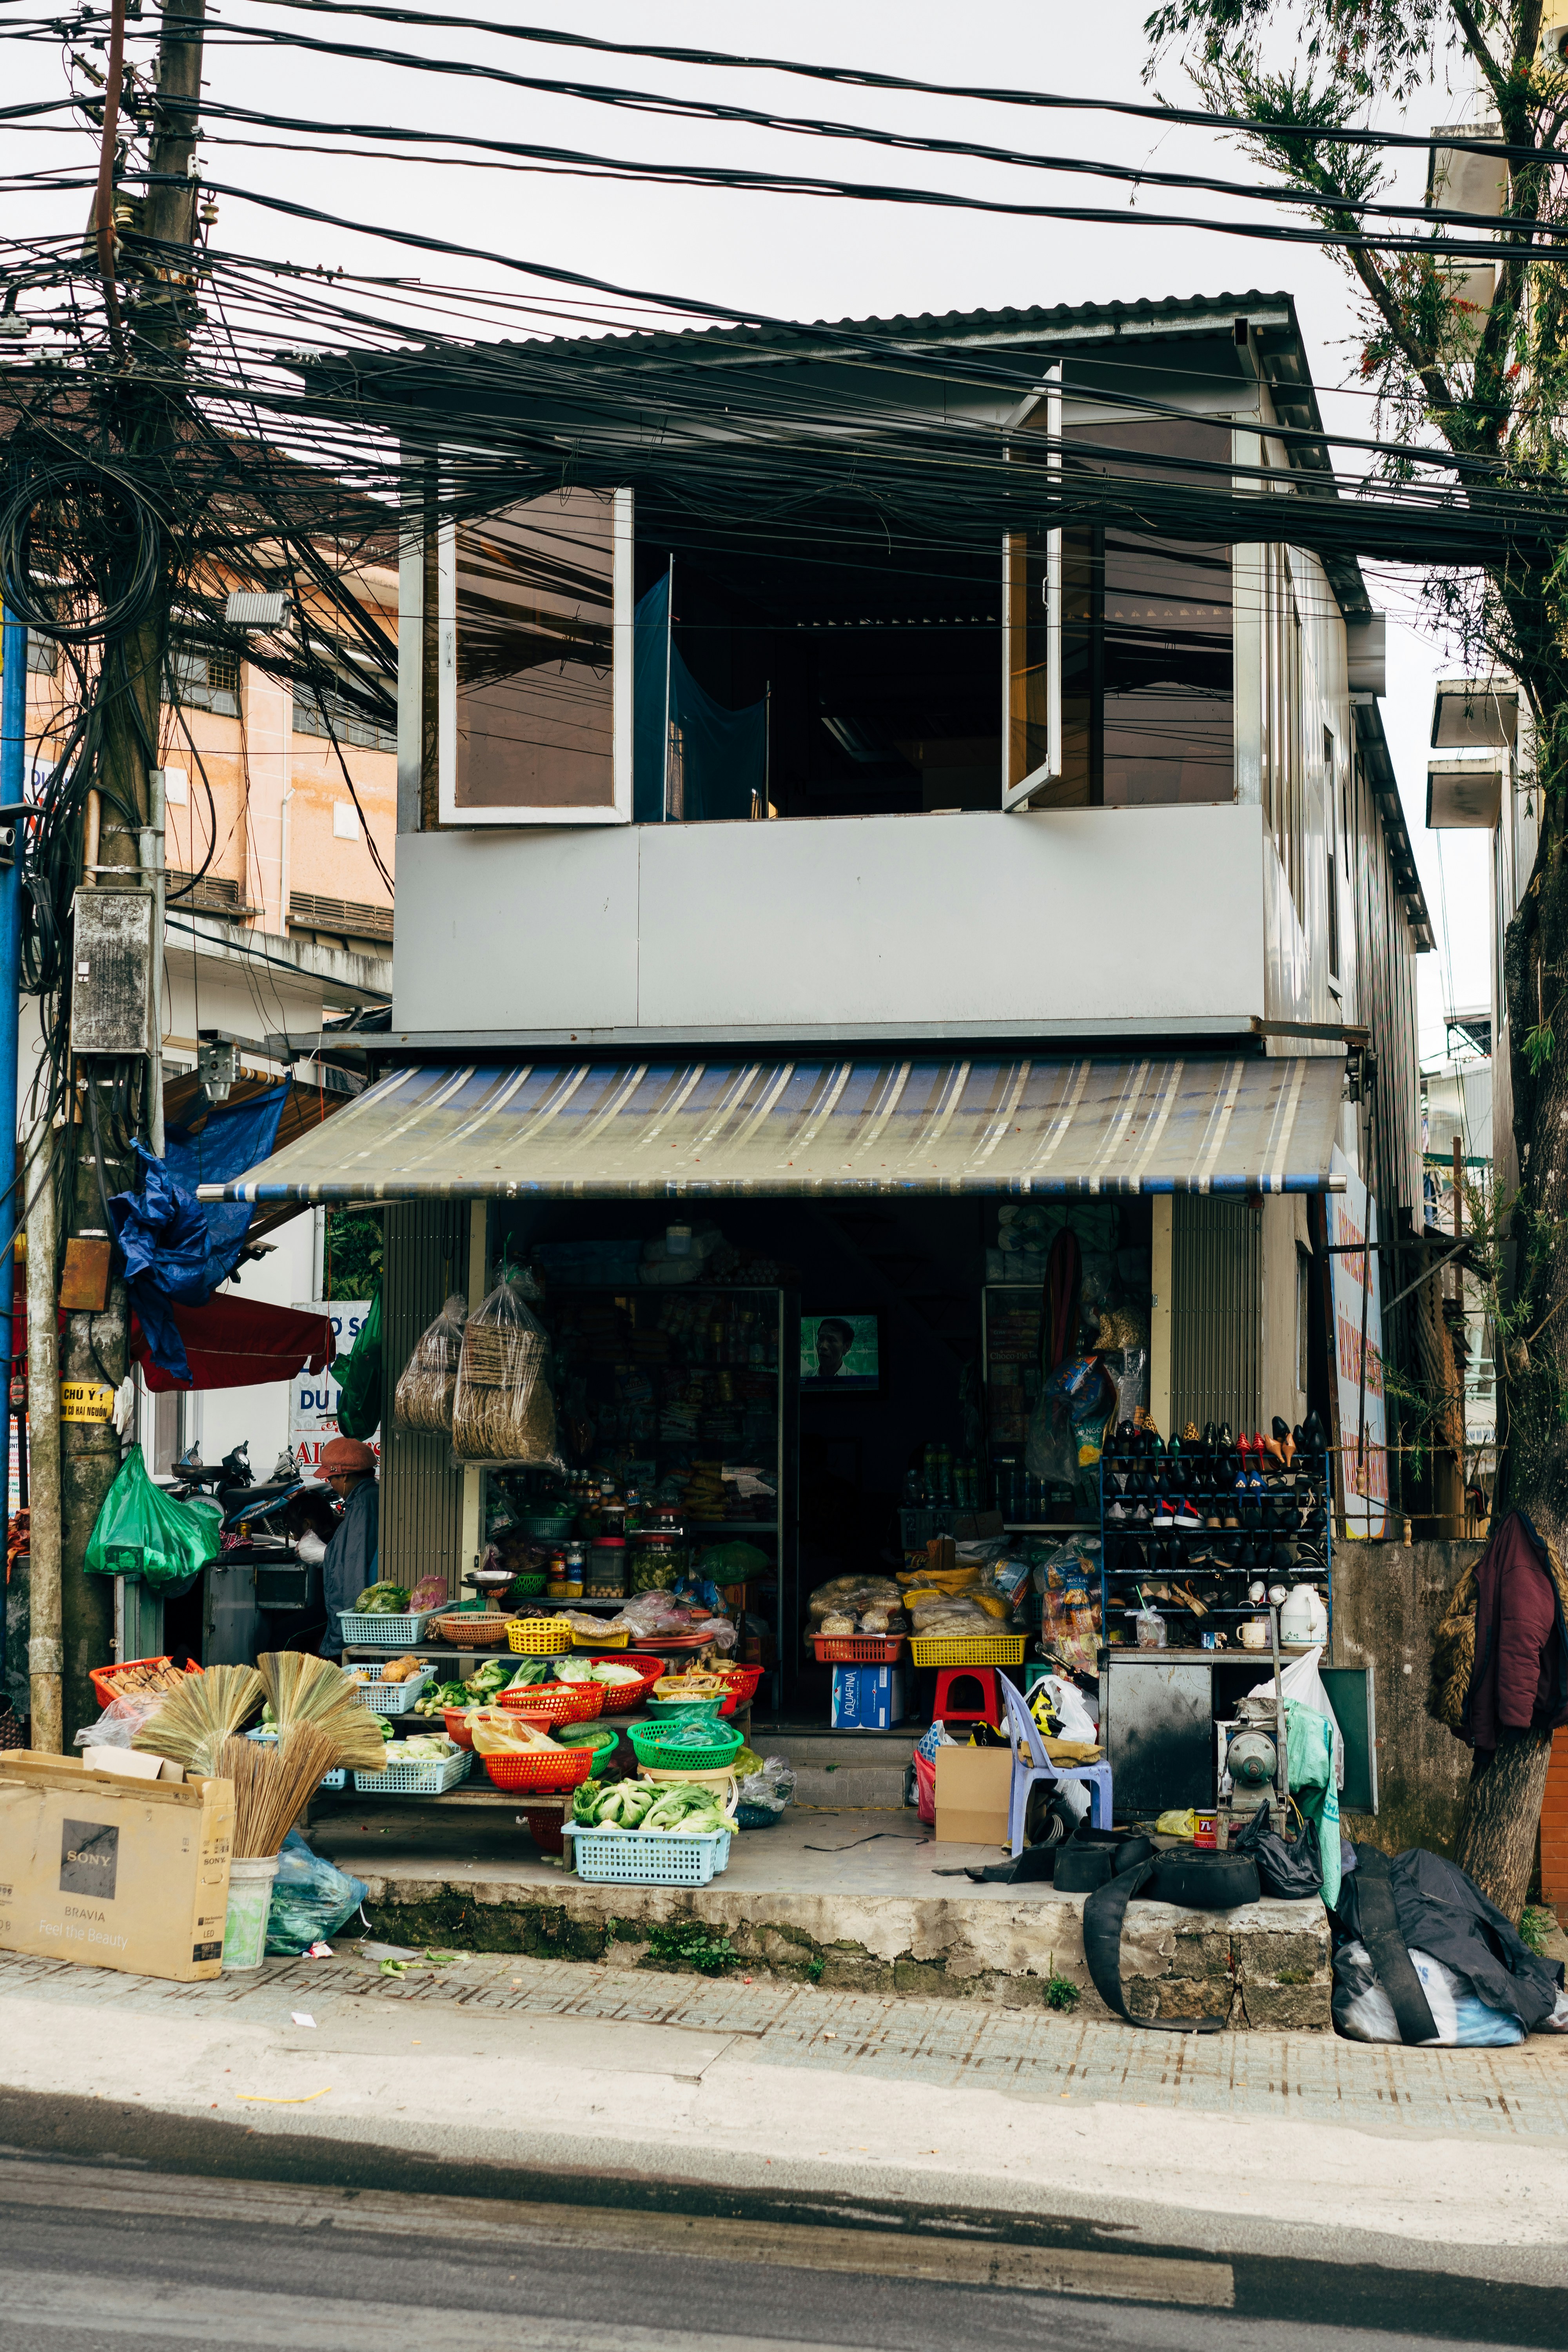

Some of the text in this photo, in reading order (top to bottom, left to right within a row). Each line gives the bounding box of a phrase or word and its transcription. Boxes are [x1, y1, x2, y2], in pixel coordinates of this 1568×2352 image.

[64, 1387, 83, 1400] CHÚ
[89, 1388, 96, 1400] Ý
[68, 1403, 74, 1415] CÓ
[76, 1406, 85, 1416] HAI
[844, 1671, 857, 1717] AQUAFINA
[67, 1850, 111, 1867] SONY
[204, 1857, 225, 1865] SONY
[64, 1906, 105, 1922] BRAVIA
[39, 1919, 129, 1951] Feel the Beauty
[203, 1929, 214, 1938] LED
